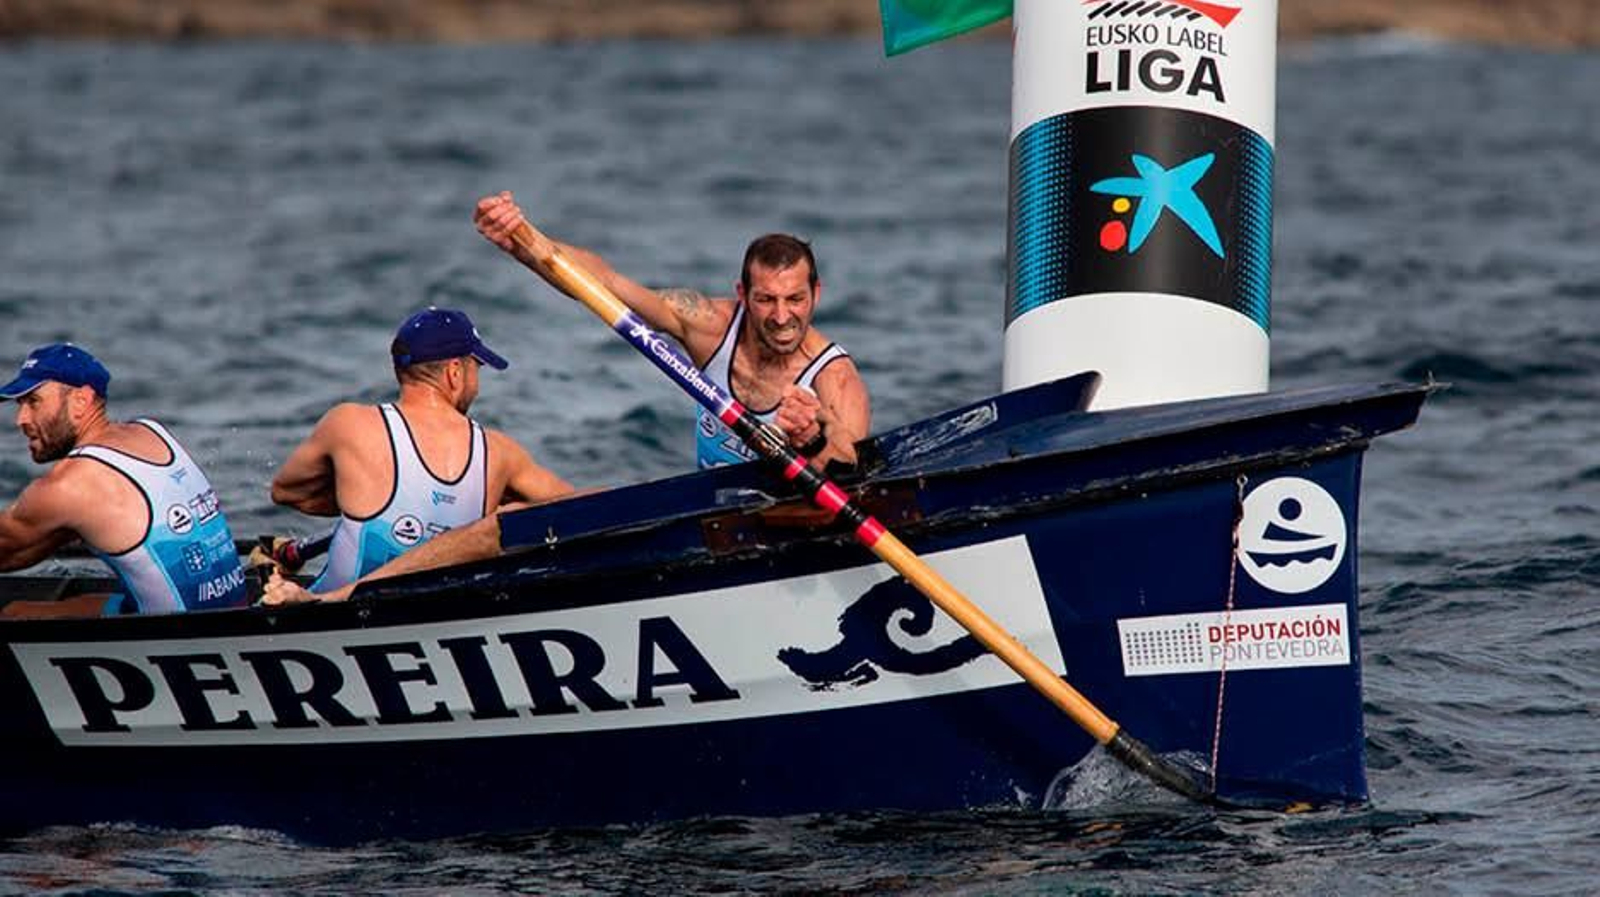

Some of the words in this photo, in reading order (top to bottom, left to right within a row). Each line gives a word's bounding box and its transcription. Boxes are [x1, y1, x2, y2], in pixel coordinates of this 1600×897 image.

[1086, 23, 1158, 47] EUSKO
[1166, 26, 1228, 57] LABEL
[1085, 49, 1226, 104] LIGA
[650, 339, 722, 402] CaixaBank
[1208, 614, 1342, 644] DEPUTACIÓN
[1209, 638, 1345, 663] PONTEVEDRA
[48, 615, 742, 734] PEREIRA
